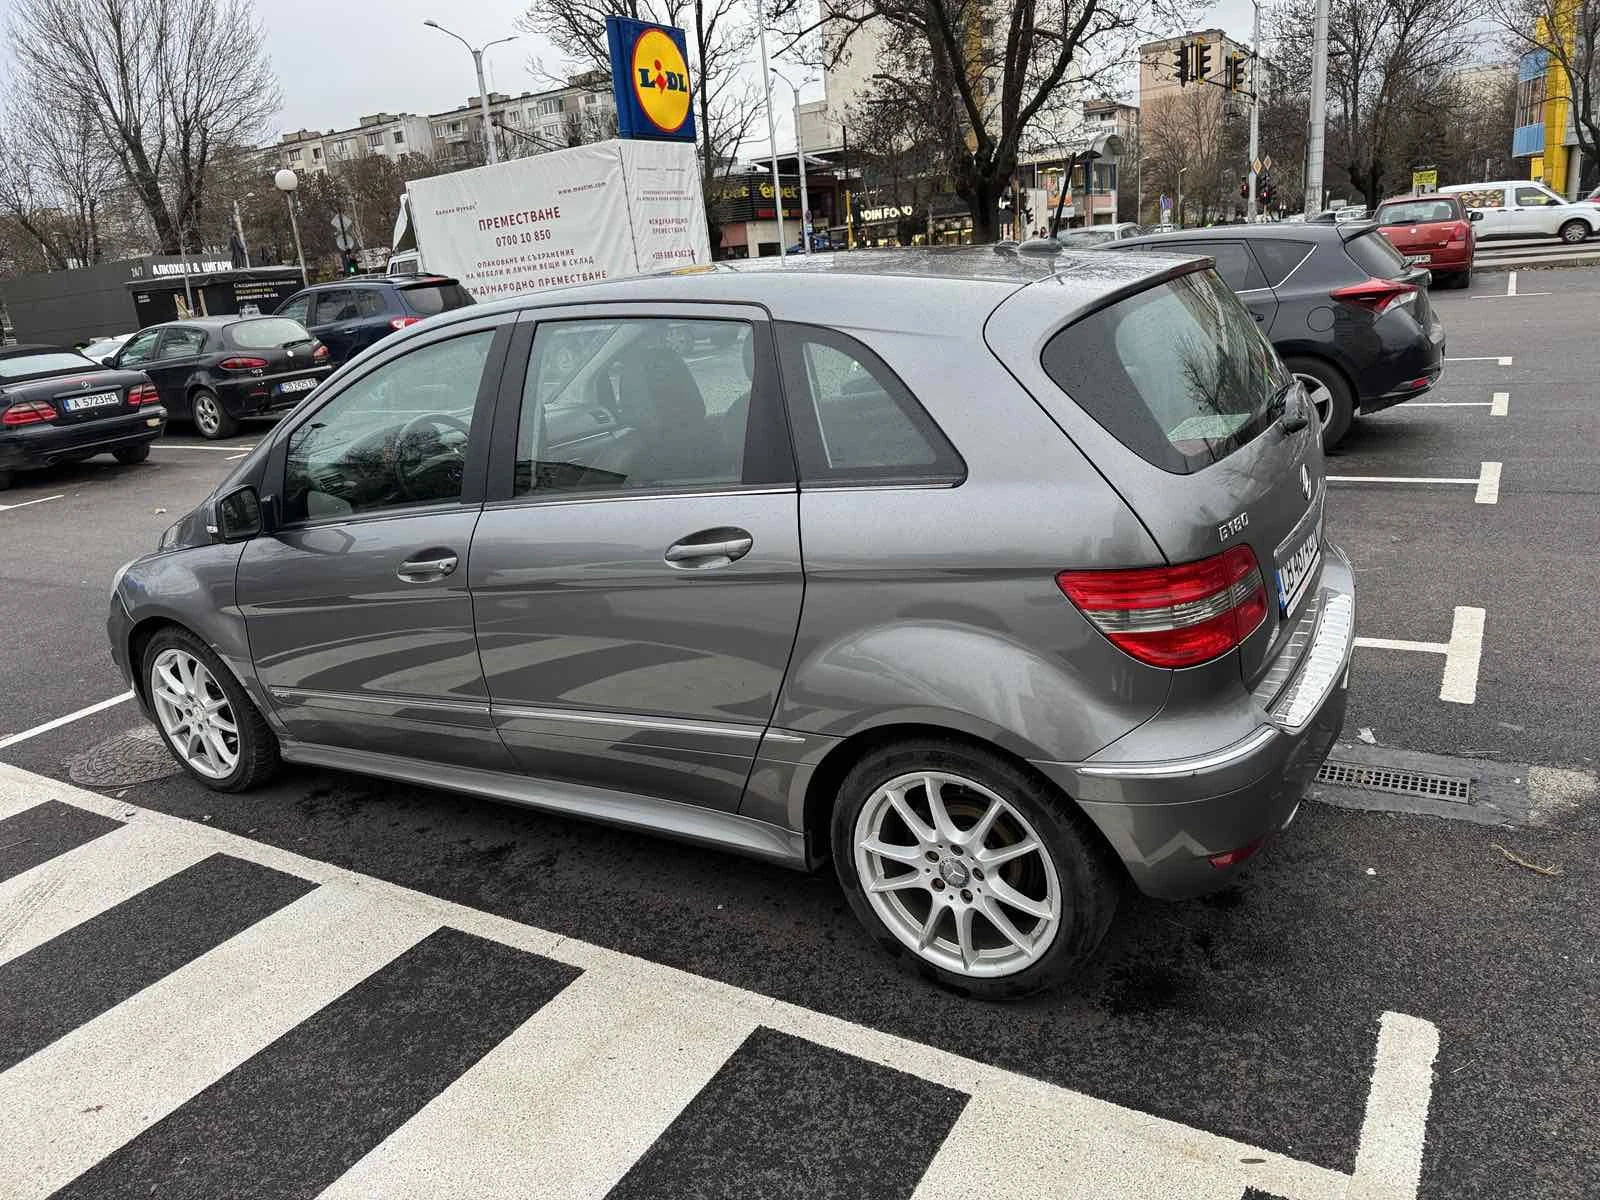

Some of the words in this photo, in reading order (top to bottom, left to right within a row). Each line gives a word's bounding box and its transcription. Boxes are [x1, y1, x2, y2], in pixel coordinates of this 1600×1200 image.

[478, 206, 561, 231] ПРЕМЕСТВАНЕ
[495, 236, 518, 247] 0700
[519, 233, 532, 244] 10
[534, 229, 551, 241] 850
[152, 263, 191, 276] АЛКОХОЛ
[193, 262, 201, 273] &
[201, 261, 233, 273] ЦИГАРИ
[477, 256, 518, 269] ОПАКОВАНЕ
[527, 248, 575, 262] СЪХРАНЕНИЕ
[539, 260, 560, 271] ВЕЩИ
[569, 256, 595, 267] СКЛАД
[465, 279, 535, 297] ЕЖДУНАРОДНО
[538, 270, 608, 288] ПРЕМЕСТВАНЕ
[1218, 512, 1249, 542] B180
